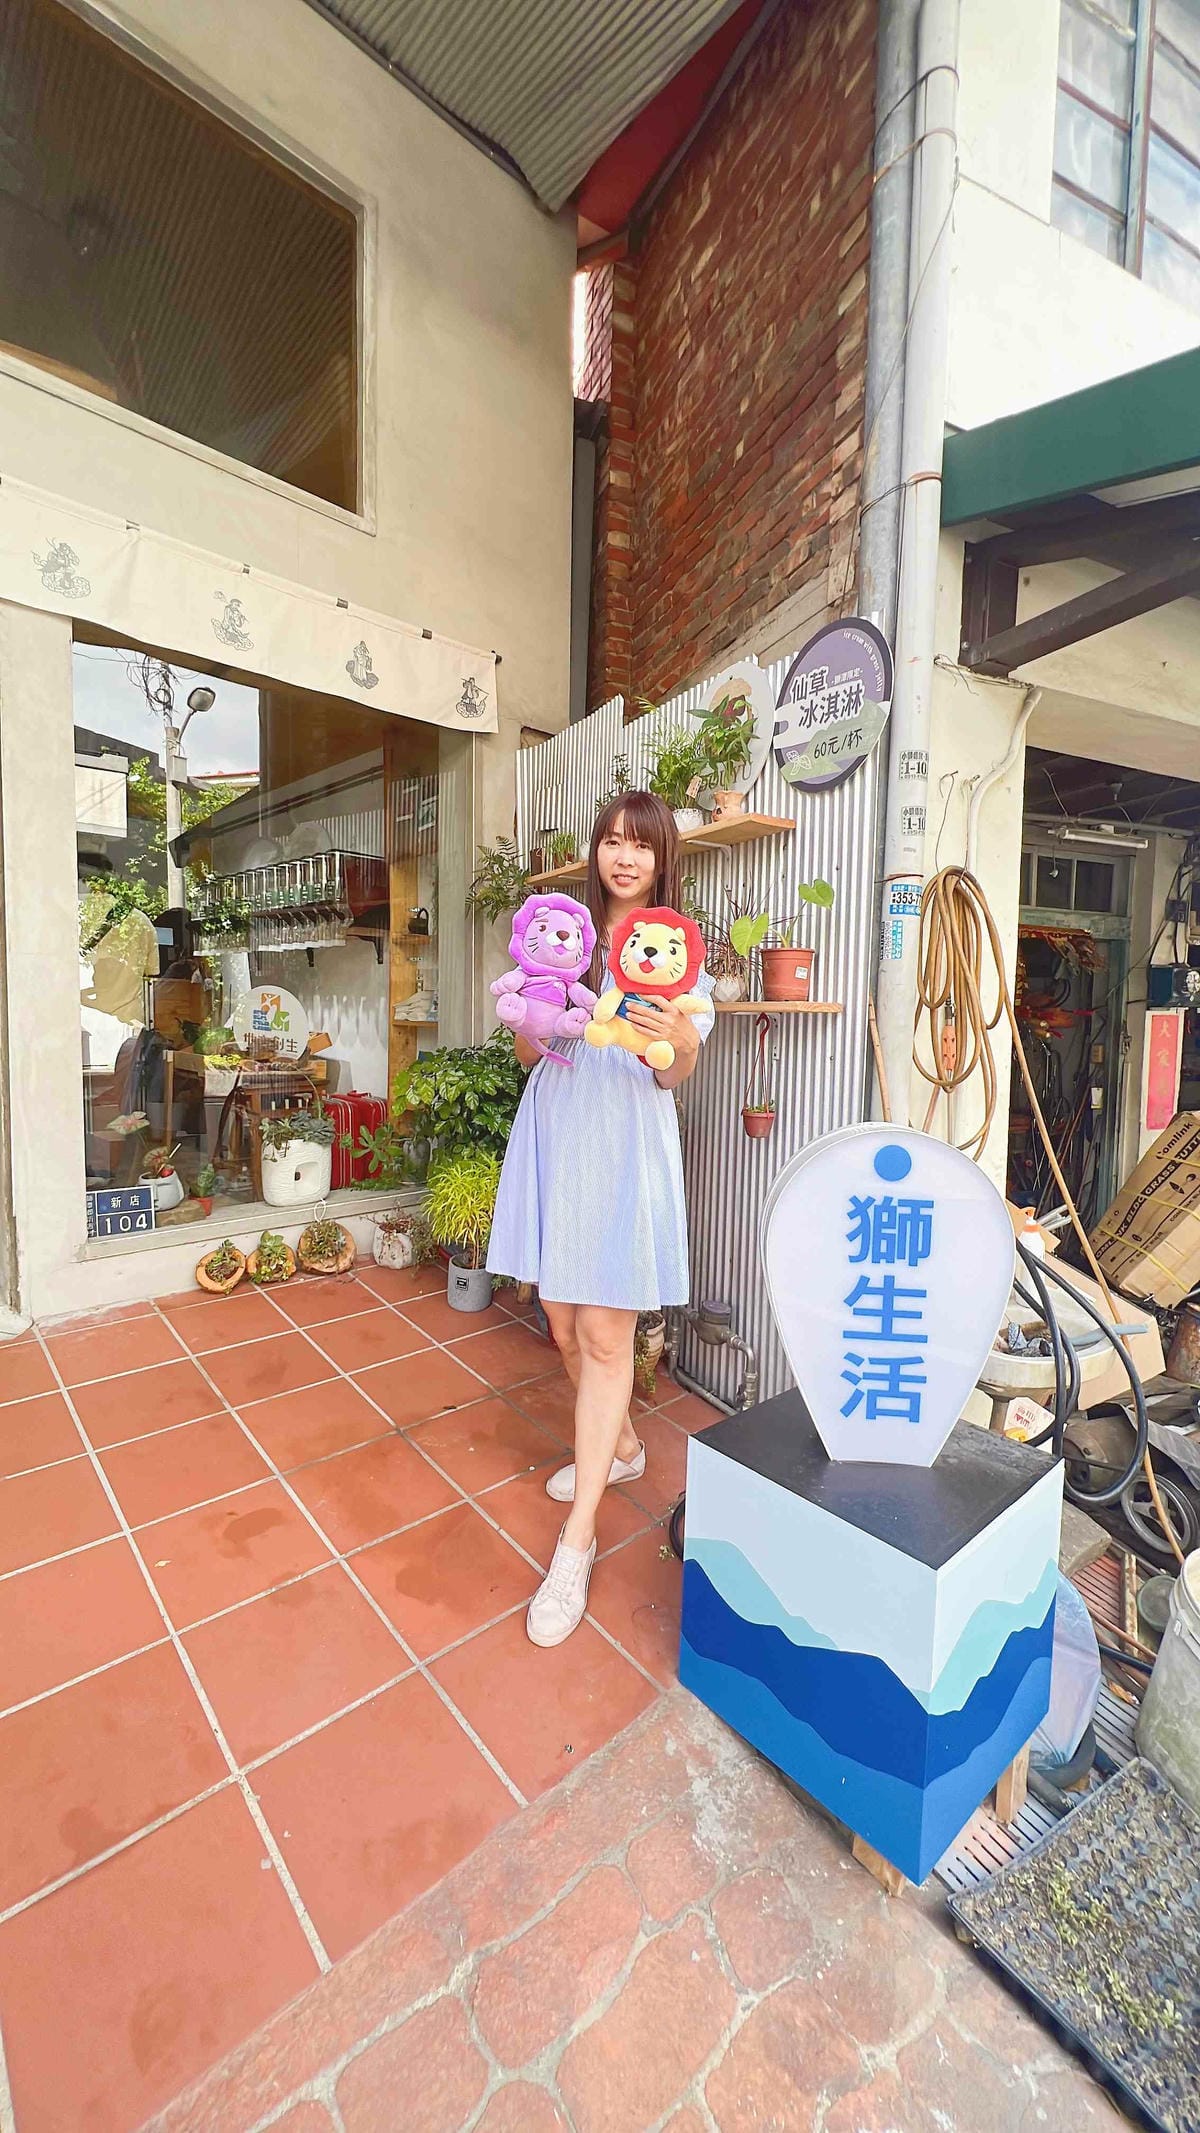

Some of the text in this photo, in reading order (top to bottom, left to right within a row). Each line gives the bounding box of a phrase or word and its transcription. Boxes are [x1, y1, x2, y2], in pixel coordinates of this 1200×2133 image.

[791, 669, 827, 704] 仙草
[798, 683, 863, 729] 冰淇淋
[813, 728, 863, 759] 60元/杯
[1144, 1163, 1176, 1196] GRASS
[110, 1194, 141, 1209] 新店
[105, 1213, 148, 1234] 104
[839, 1194, 935, 1424] 獅生活
